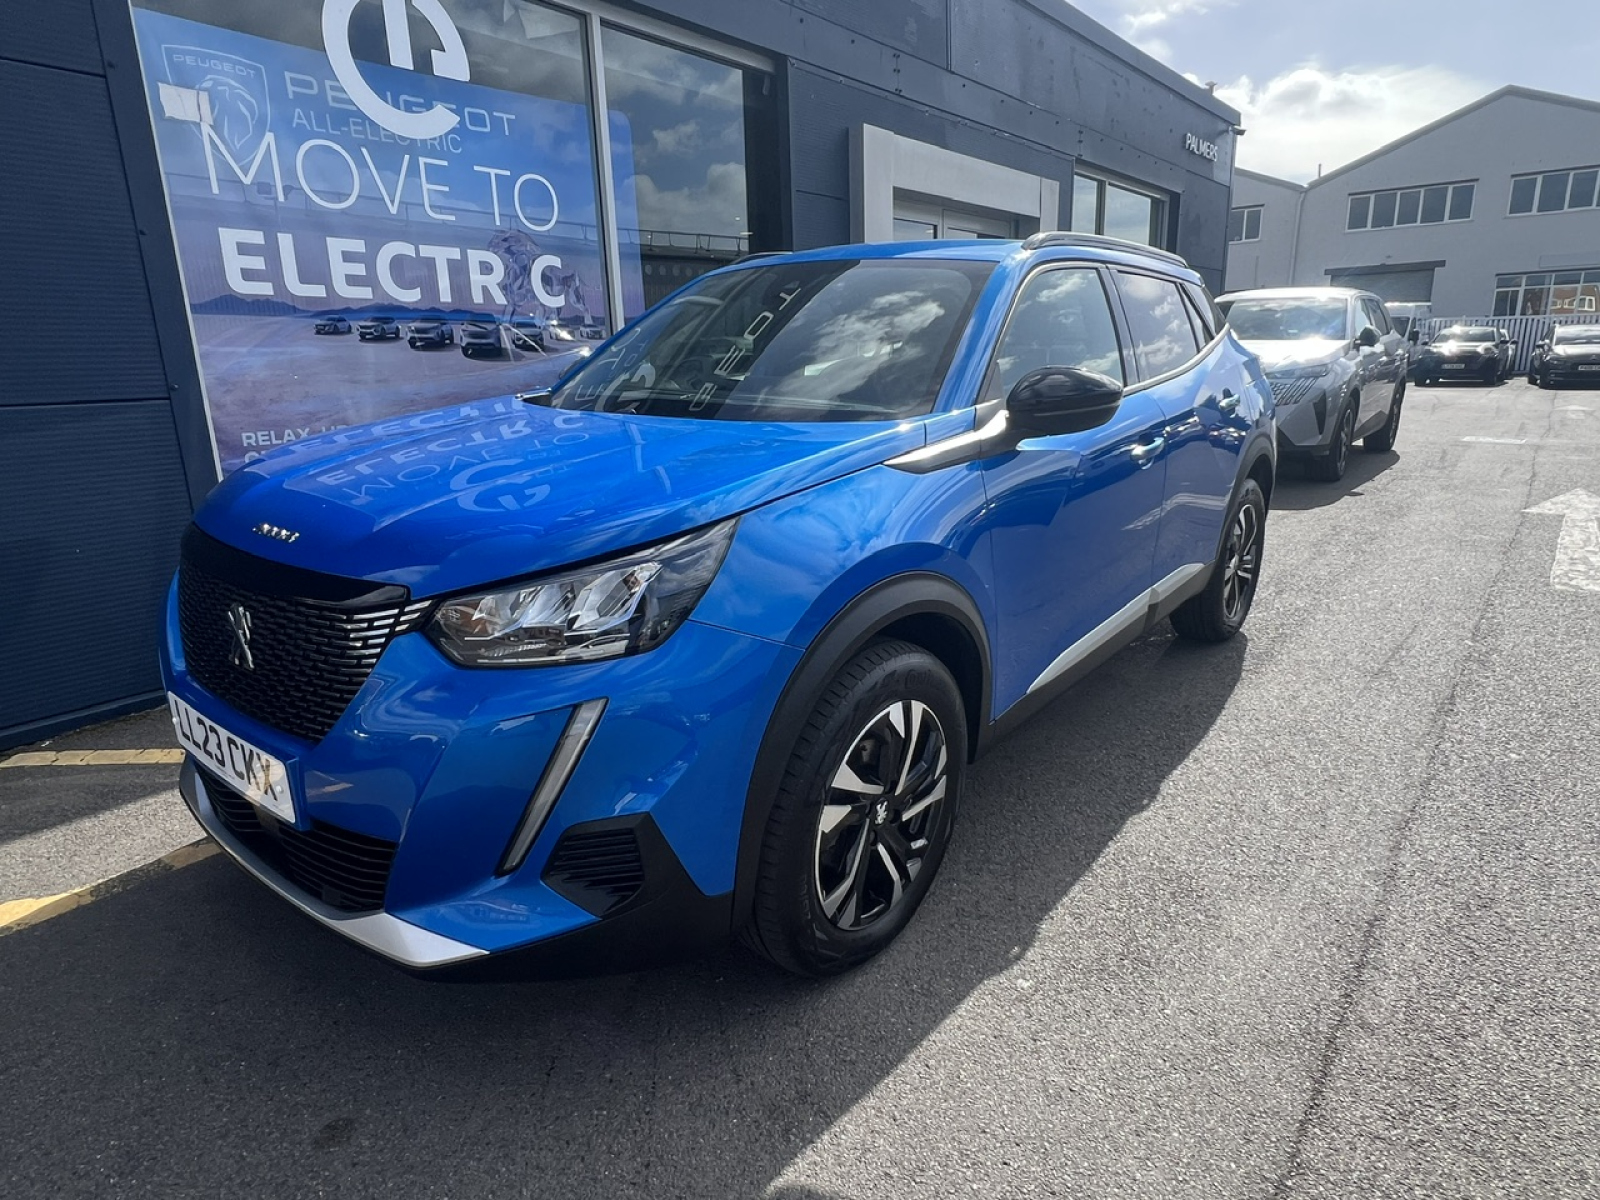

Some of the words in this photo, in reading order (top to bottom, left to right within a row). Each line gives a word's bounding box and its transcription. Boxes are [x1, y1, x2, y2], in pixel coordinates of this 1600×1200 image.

[173, 54, 256, 79] PEUGEOT
[1185, 132, 1218, 161] PALMERS
[200, 124, 456, 221] MOVE
[473, 165, 560, 231] TO
[241, 427, 310, 447] RELAX
[174, 699, 226, 768] LL23
